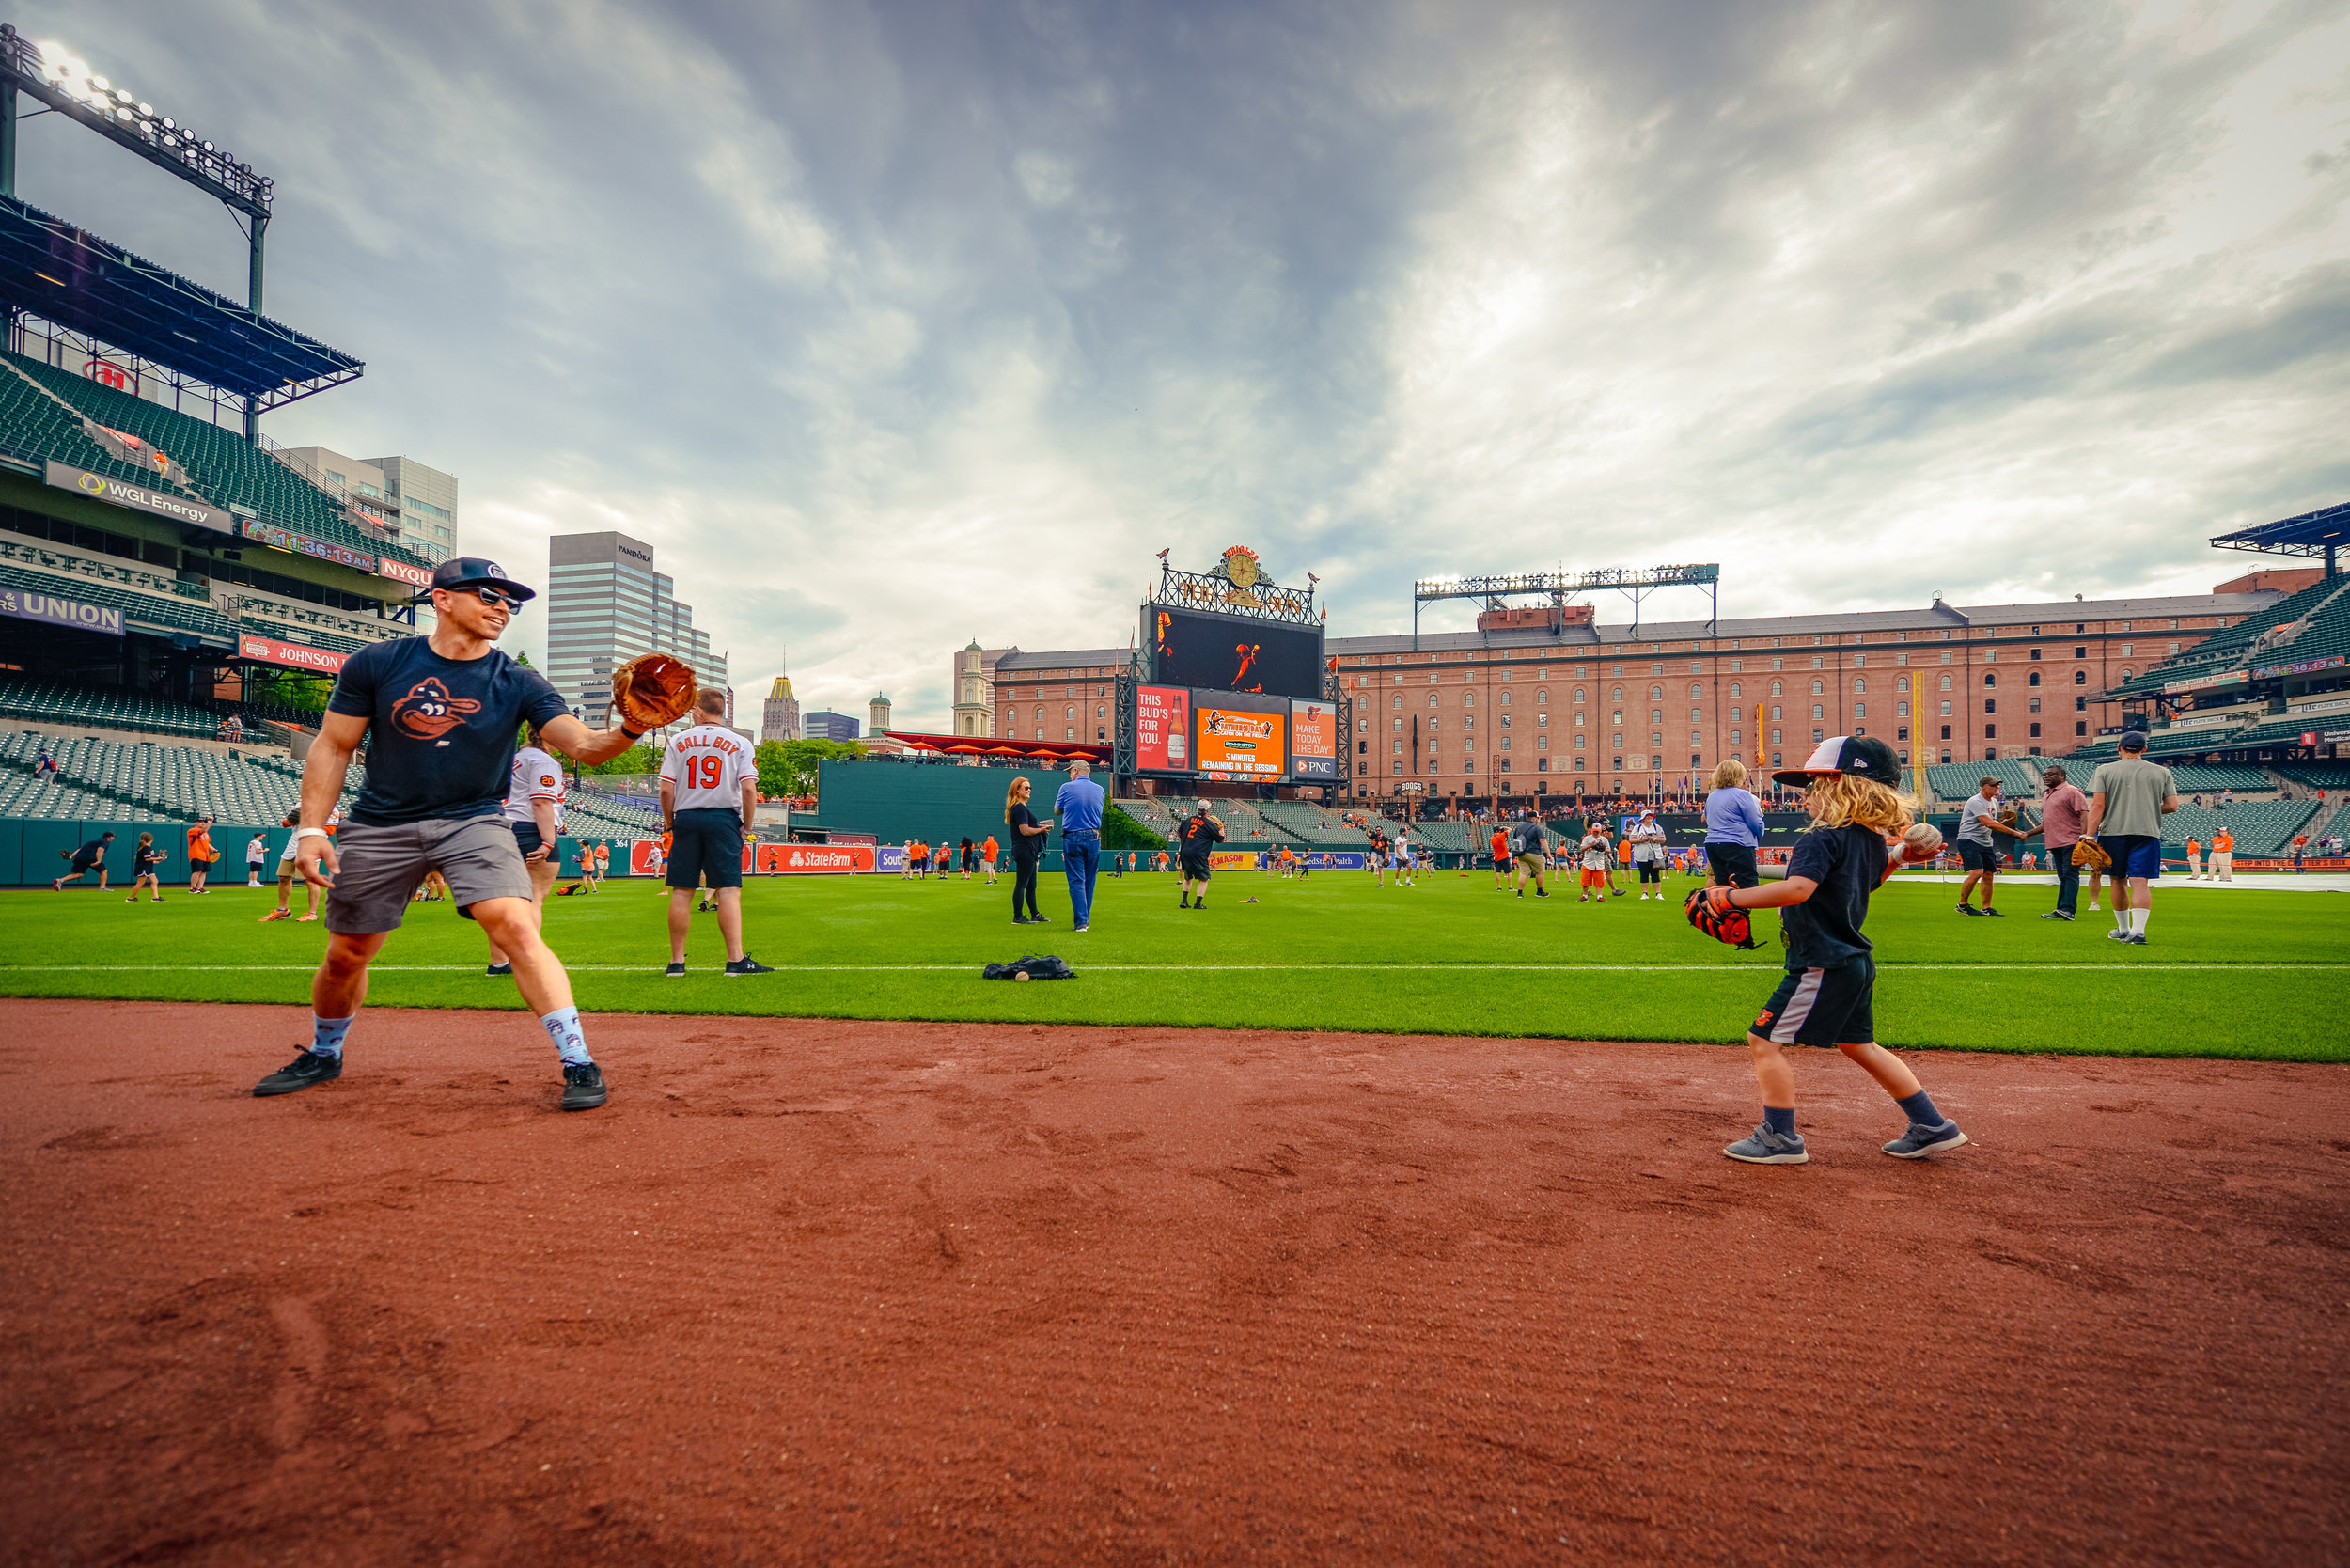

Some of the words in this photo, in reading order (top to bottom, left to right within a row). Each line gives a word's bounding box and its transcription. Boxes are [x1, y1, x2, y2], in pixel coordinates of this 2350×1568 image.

[109, 482, 149, 506] WGL
[152, 495, 208, 523] Energy
[280, 533, 352, 564] 11:36:13
[354, 557, 370, 568] AM
[1180, 582, 1216, 603] THE
[1267, 595, 1301, 615] SUN
[24, 592, 119, 628] UNION
[279, 647, 337, 668] JOHNSON
[1139, 694, 1161, 706] THIS
[1139, 707, 1168, 719] BUD'S
[1139, 720, 1158, 731] FOR
[1220, 723, 1249, 732] FATHER'S
[1250, 724, 1262, 733] DAY
[1296, 724, 1320, 733] MAKE
[1139, 732, 1161, 745] YOU.
[1296, 734, 1322, 744] TODAY
[677, 735, 710, 753] BALL
[713, 736, 740, 756] BOY
[1296, 744, 1311, 753] THE
[1231, 753, 1255, 762] MINUTES
[686, 755, 722, 789] 19
[1202, 760, 1233, 770] REMAINING
[1255, 763, 1277, 772] SESSION
[1308, 761, 1331, 773] PNC
[541, 776, 554, 785] 20
[1187, 824, 1198, 839] 2
[614, 839, 628, 848] 364
